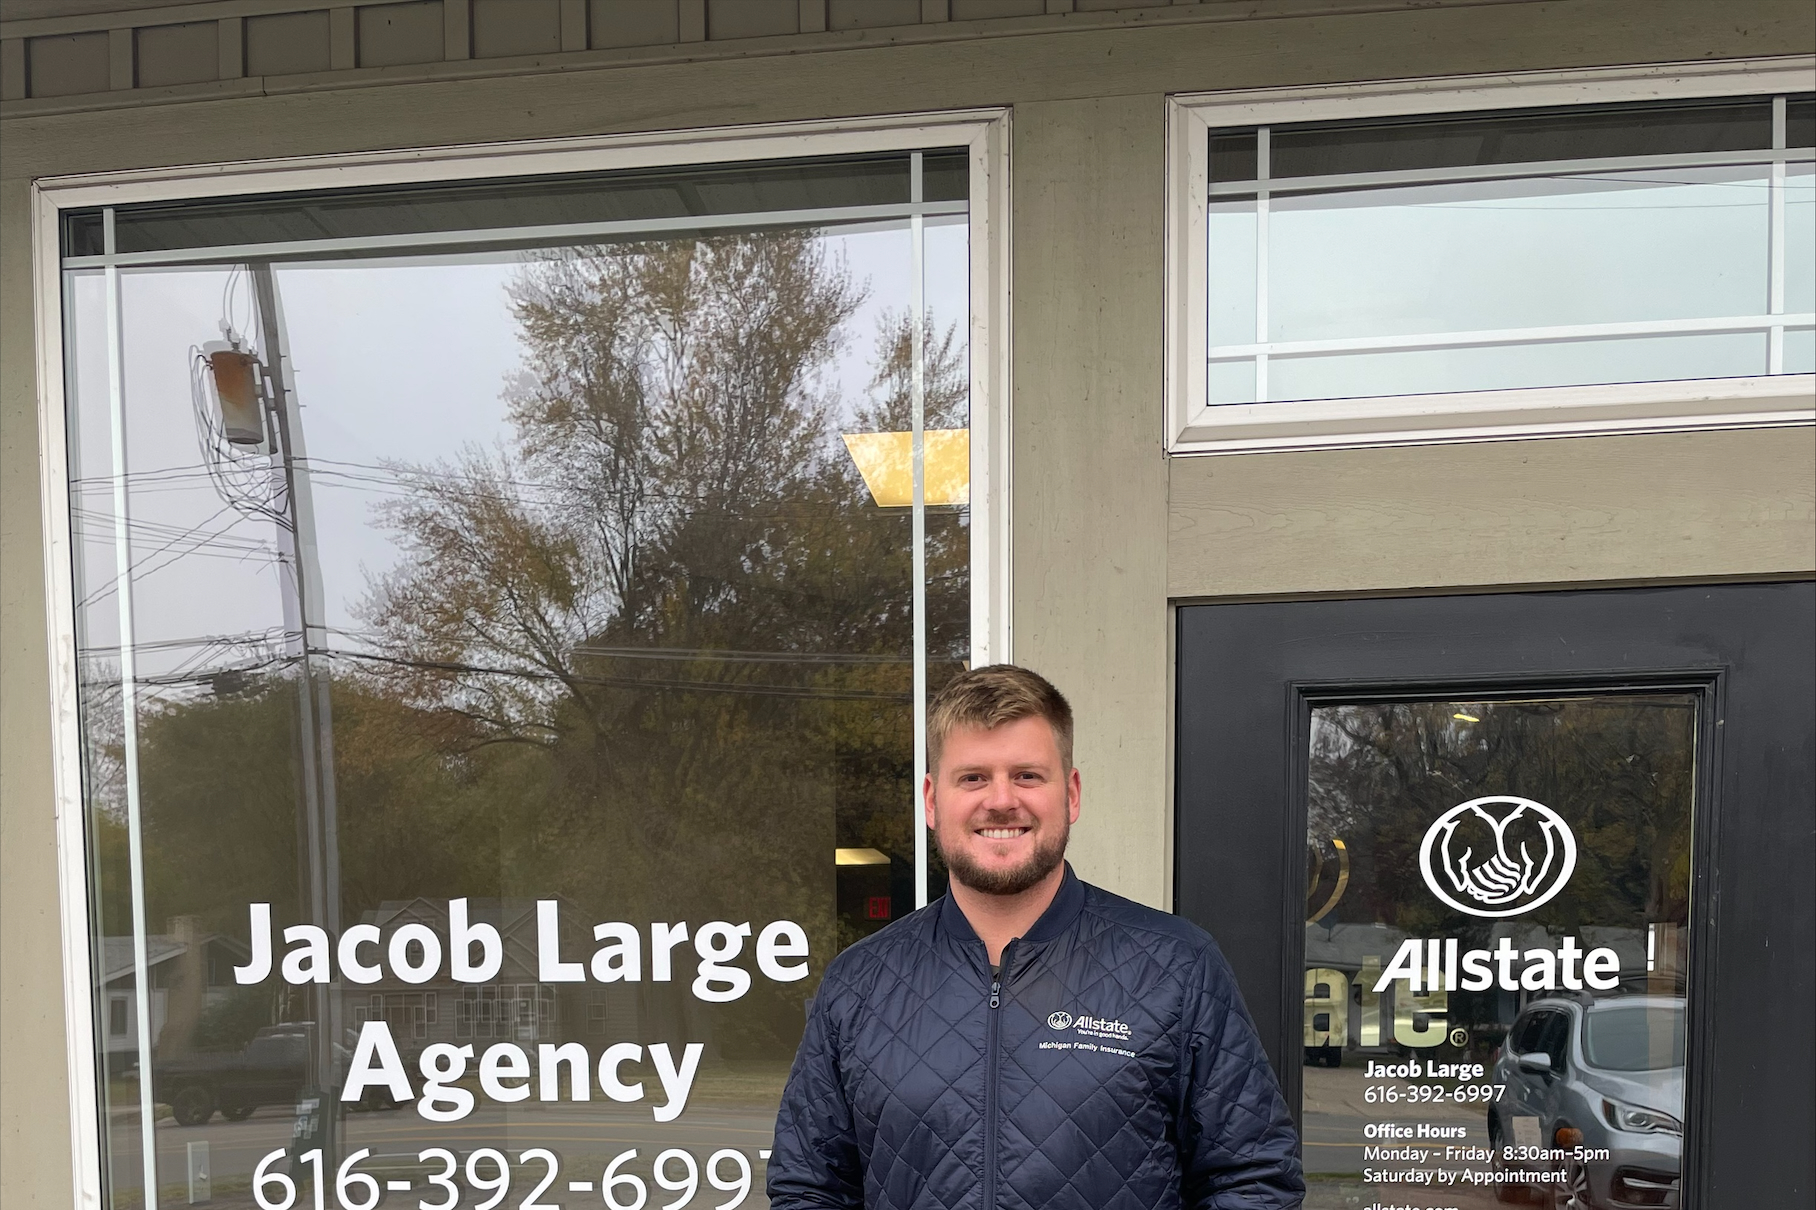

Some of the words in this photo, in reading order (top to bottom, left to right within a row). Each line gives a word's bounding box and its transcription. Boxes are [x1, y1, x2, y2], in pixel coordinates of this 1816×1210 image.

[234, 898, 503, 985] Jacob
[537, 900, 810, 1002] Large
[1372, 937, 1620, 992] Allstate
[1074, 1042, 1098, 1051] Family
[1100, 1045, 1135, 1057] Insurance
[341, 1021, 704, 1123] Agency
[1364, 1060, 1421, 1079] Jacob
[1427, 1060, 1484, 1081] Large
[1364, 1084, 1506, 1103] 616-392-6997
[1364, 1124, 1413, 1138] Office
[1417, 1124, 1466, 1138] Hours
[1364, 1146, 1428, 1163] Monday
[1446, 1146, 1494, 1163] Friday
[1363, 1169, 1435, 1185] Saturday
[1438, 1169, 1456, 1185] by
[1461, 1169, 1567, 1185] Appointment
